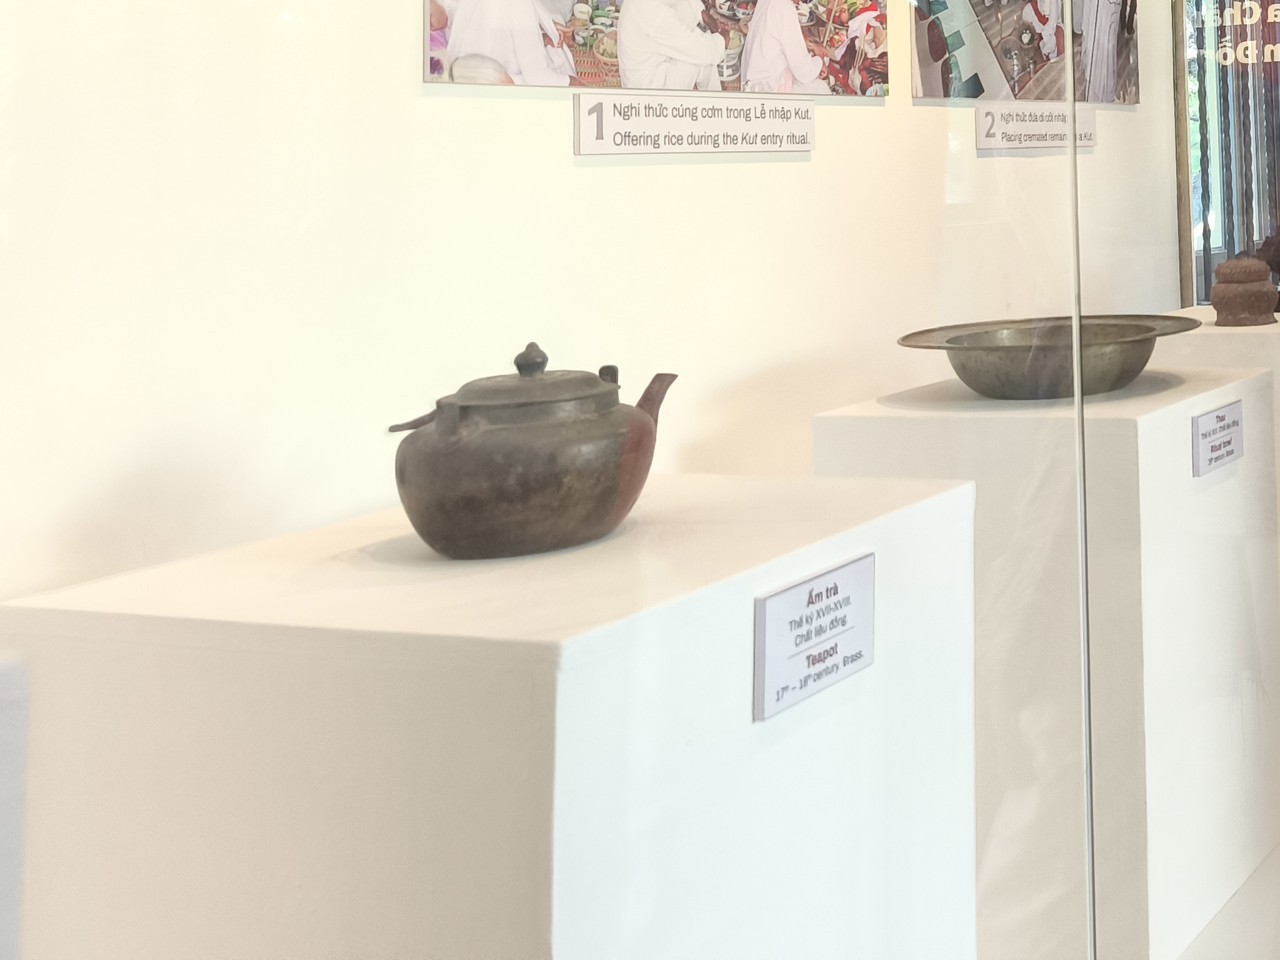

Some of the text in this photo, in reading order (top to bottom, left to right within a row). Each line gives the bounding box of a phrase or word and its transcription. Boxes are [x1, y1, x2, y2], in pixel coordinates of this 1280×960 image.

[588, 102, 812, 141] 1 Nghi thức cúng cơm trong Lễ nhập Kut.
[984, 111, 996, 139] 2
[612, 131, 811, 149] Offering rice during the Kut entry ritual.
[824, 581, 839, 599] trà
[804, 641, 838, 669] Teapot
